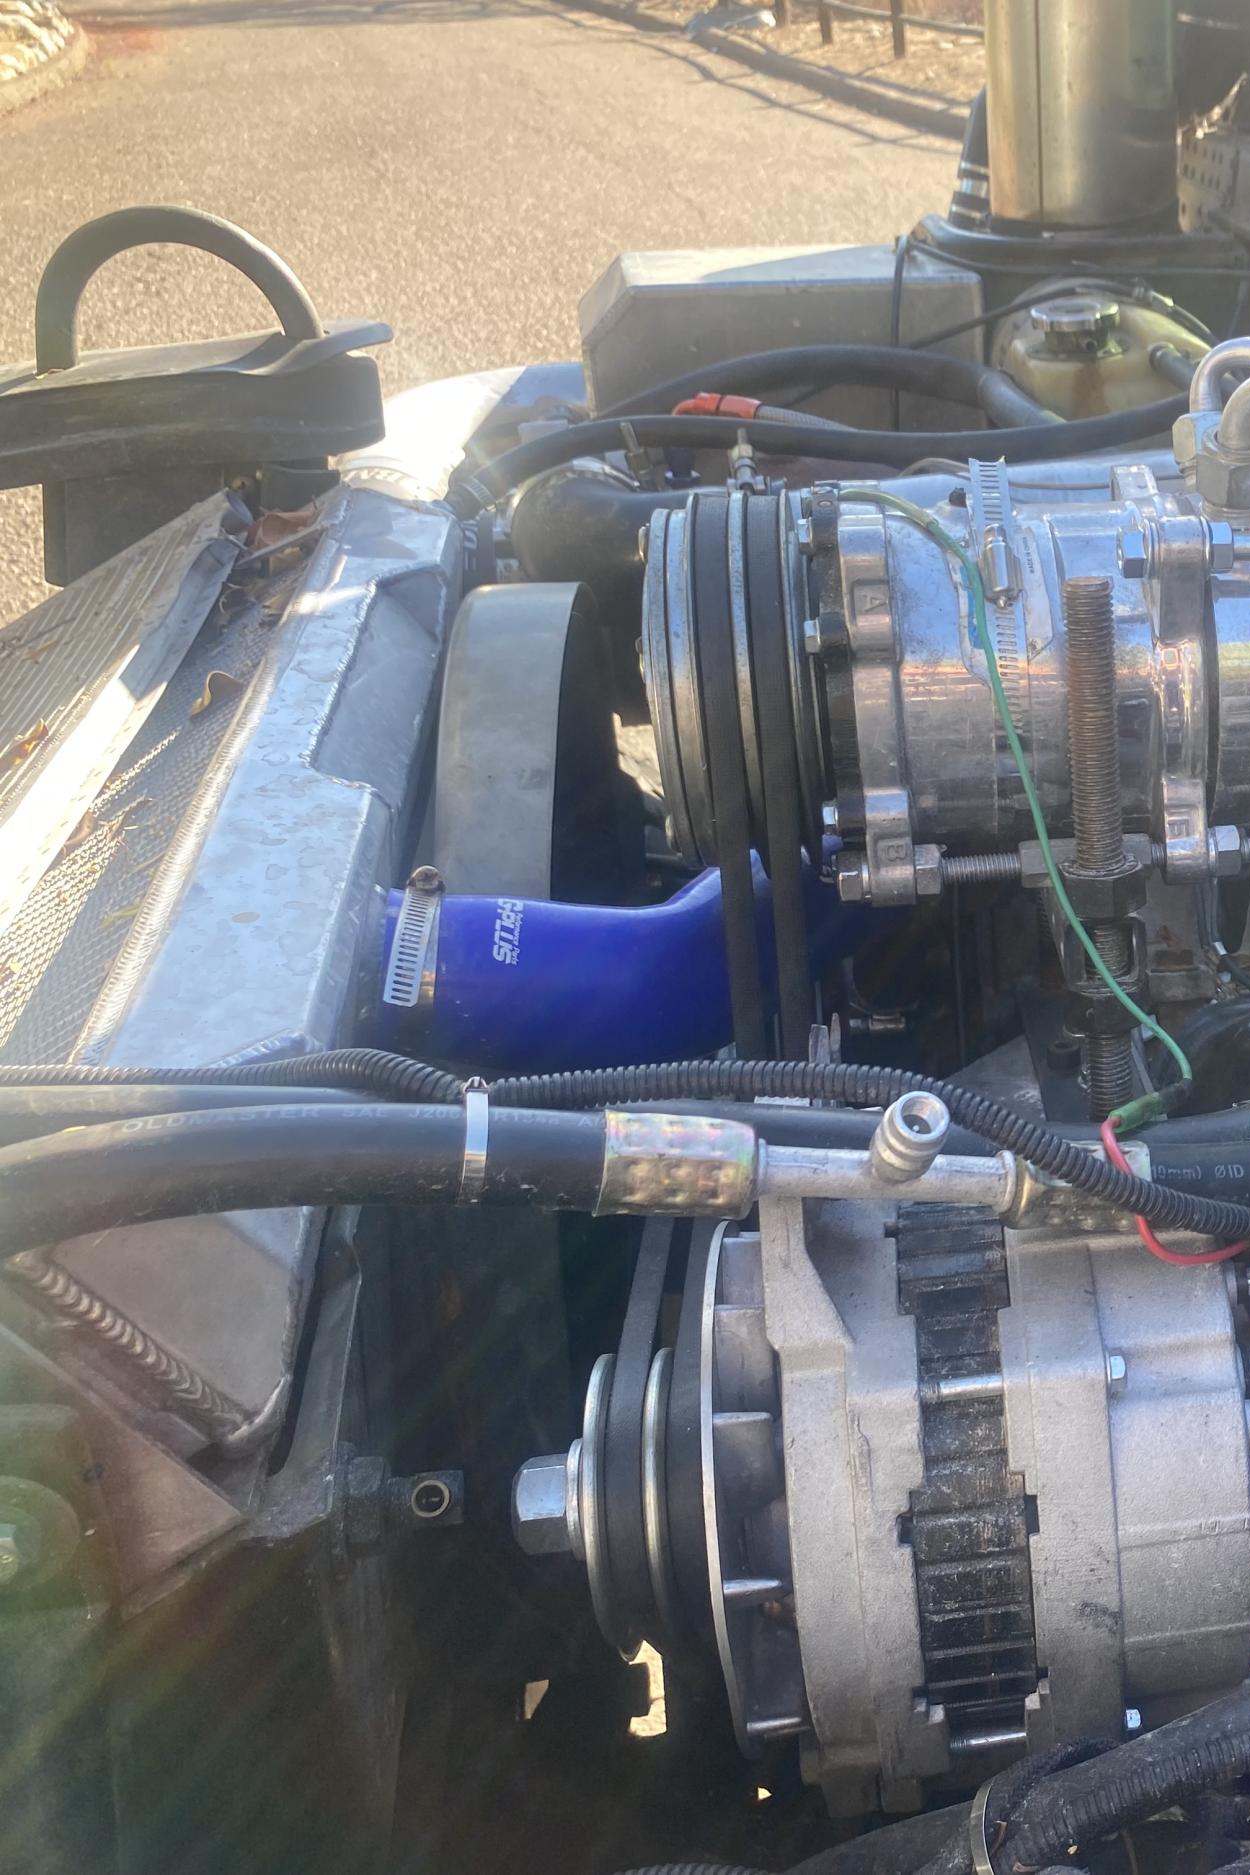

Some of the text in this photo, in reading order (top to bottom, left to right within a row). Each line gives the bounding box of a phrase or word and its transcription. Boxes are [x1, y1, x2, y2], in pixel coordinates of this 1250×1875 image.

[120, 1107, 320, 1133] OLDMASTER
[408, 1106, 463, 1119] J206
[1151, 1165, 1203, 1180] 10mm)
